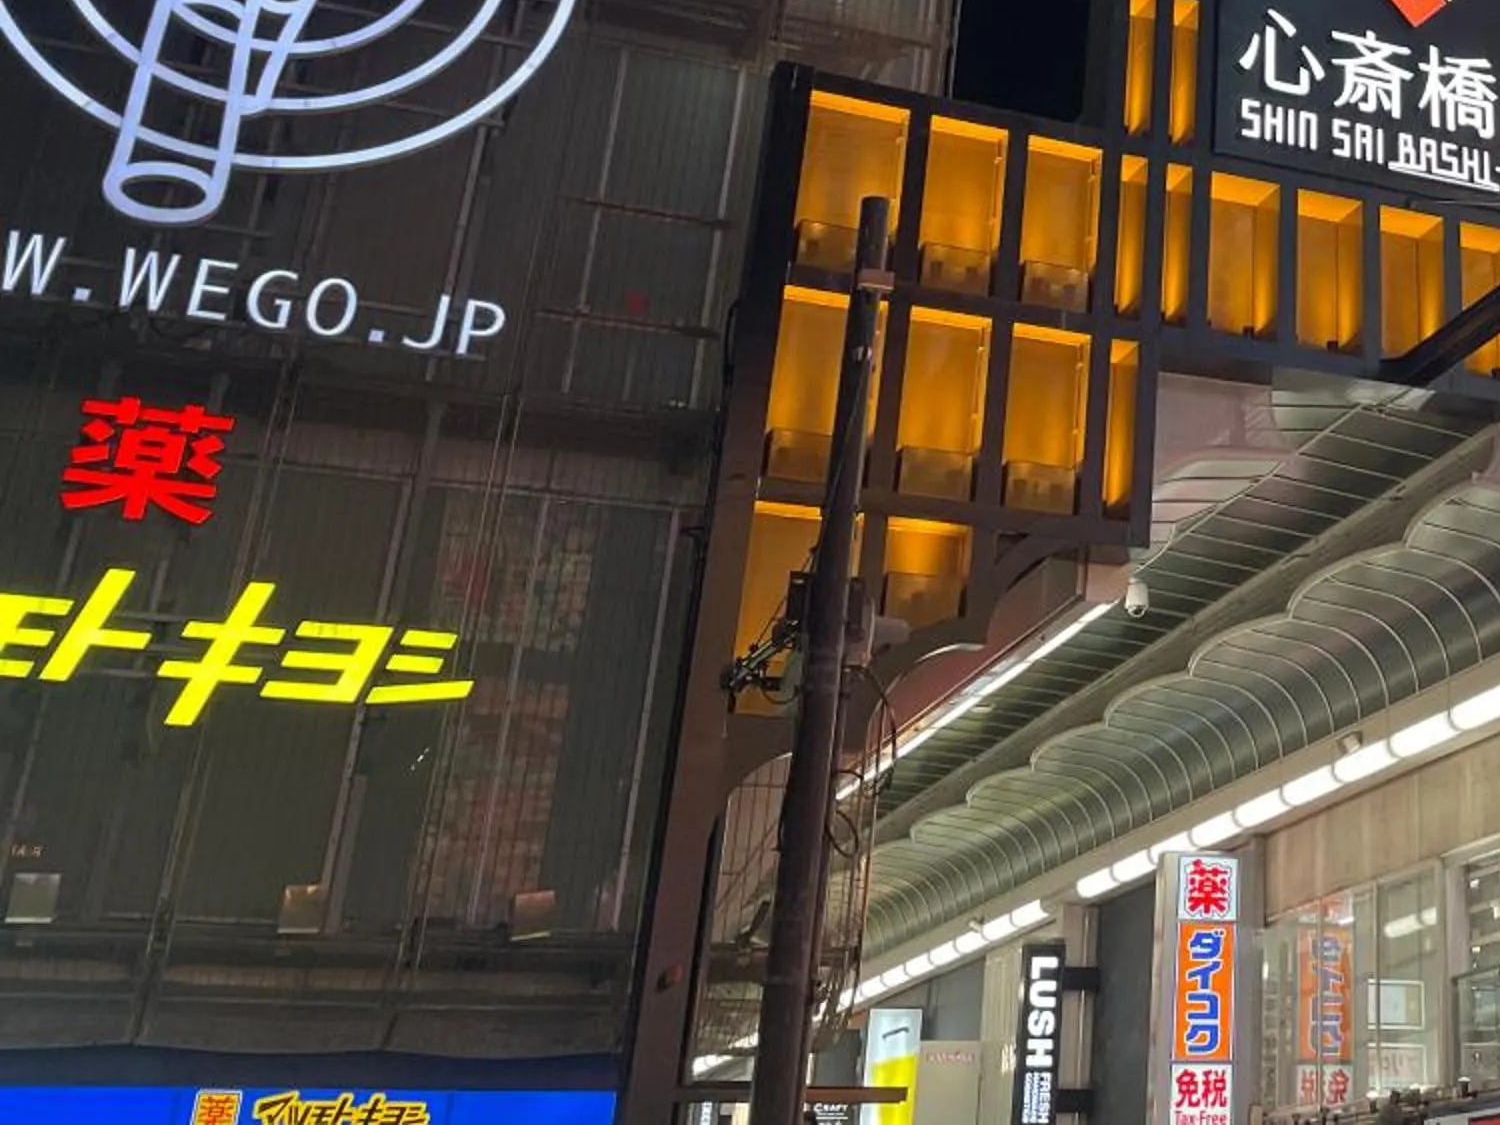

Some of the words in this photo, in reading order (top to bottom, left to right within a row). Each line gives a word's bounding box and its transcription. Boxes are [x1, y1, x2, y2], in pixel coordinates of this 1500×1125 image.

[61, 396, 236, 526] 薬
[1184, 858, 1229, 915] 薬
[1025, 955, 1060, 1068] LUSH
[1184, 929, 1225, 1056] ダイコク
[1175, 1069, 1228, 1109] 免税
